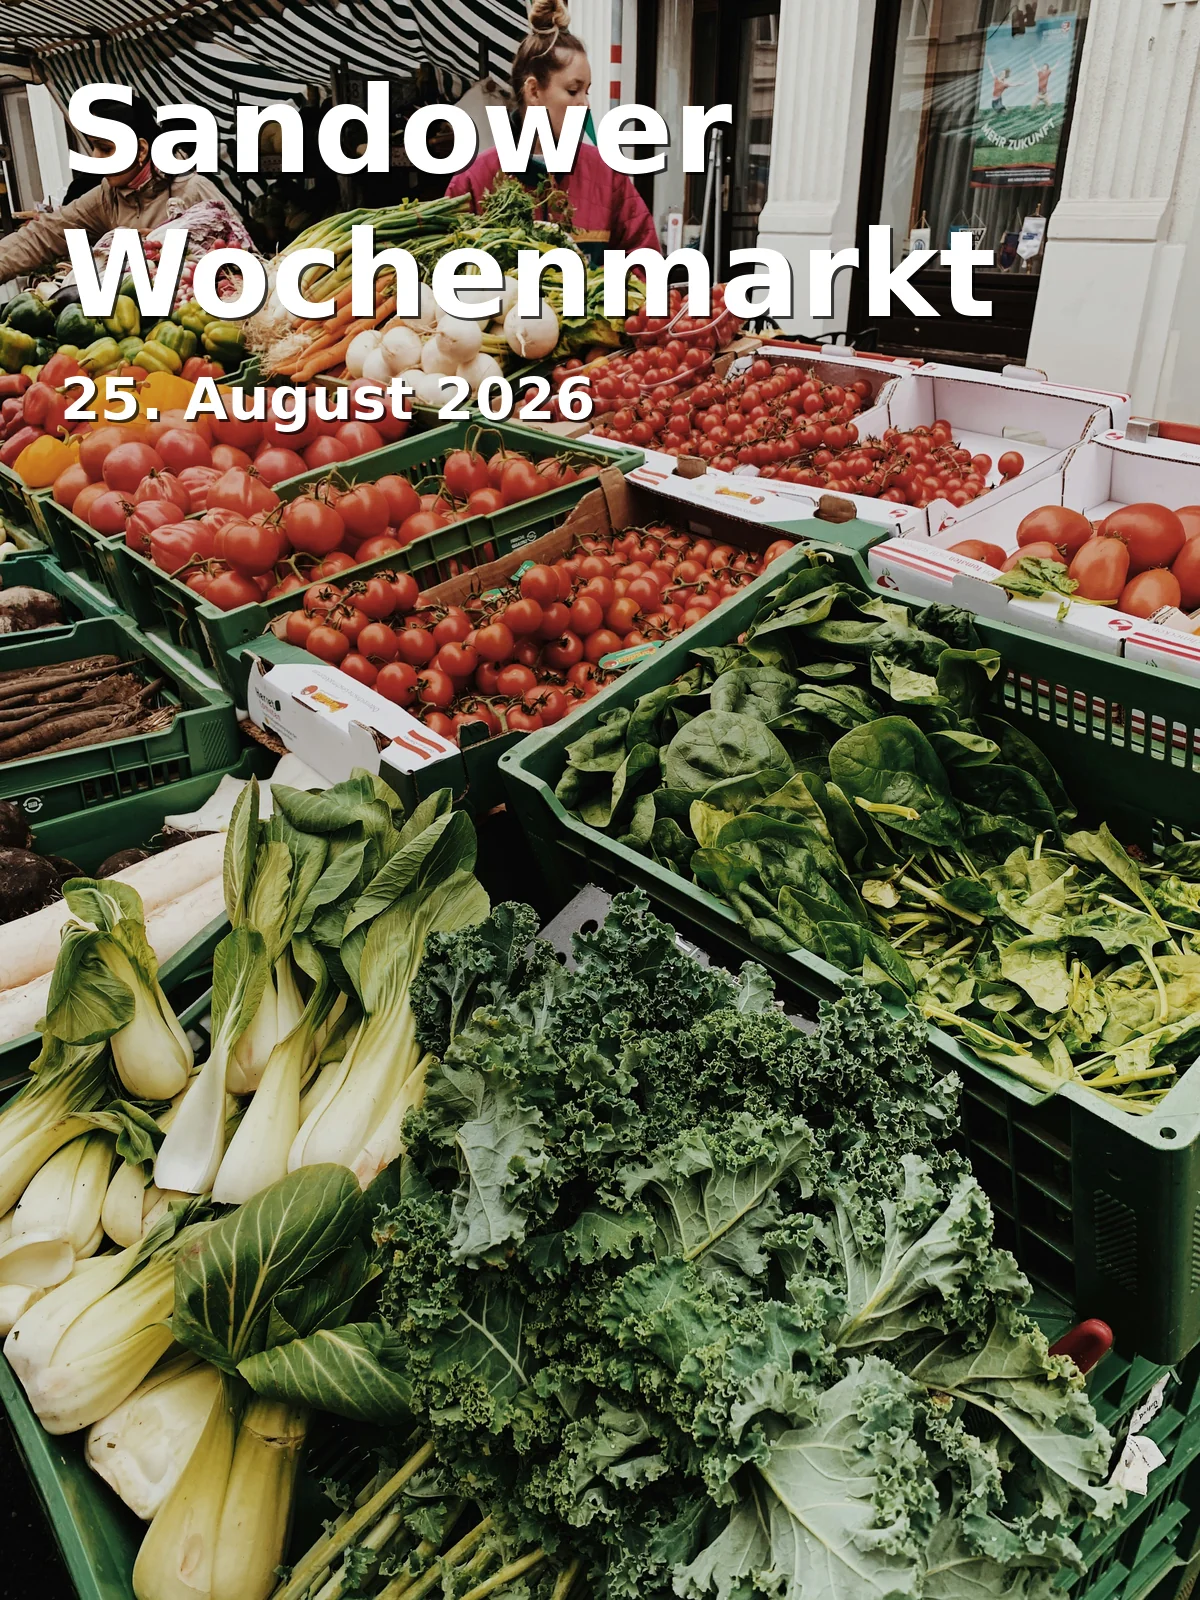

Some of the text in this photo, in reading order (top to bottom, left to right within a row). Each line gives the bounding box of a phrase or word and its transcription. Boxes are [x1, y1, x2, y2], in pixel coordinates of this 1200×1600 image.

[981, 117, 1055, 151] MEHR ZUKUNFT
[948, 555, 982, 573] Tomaten
